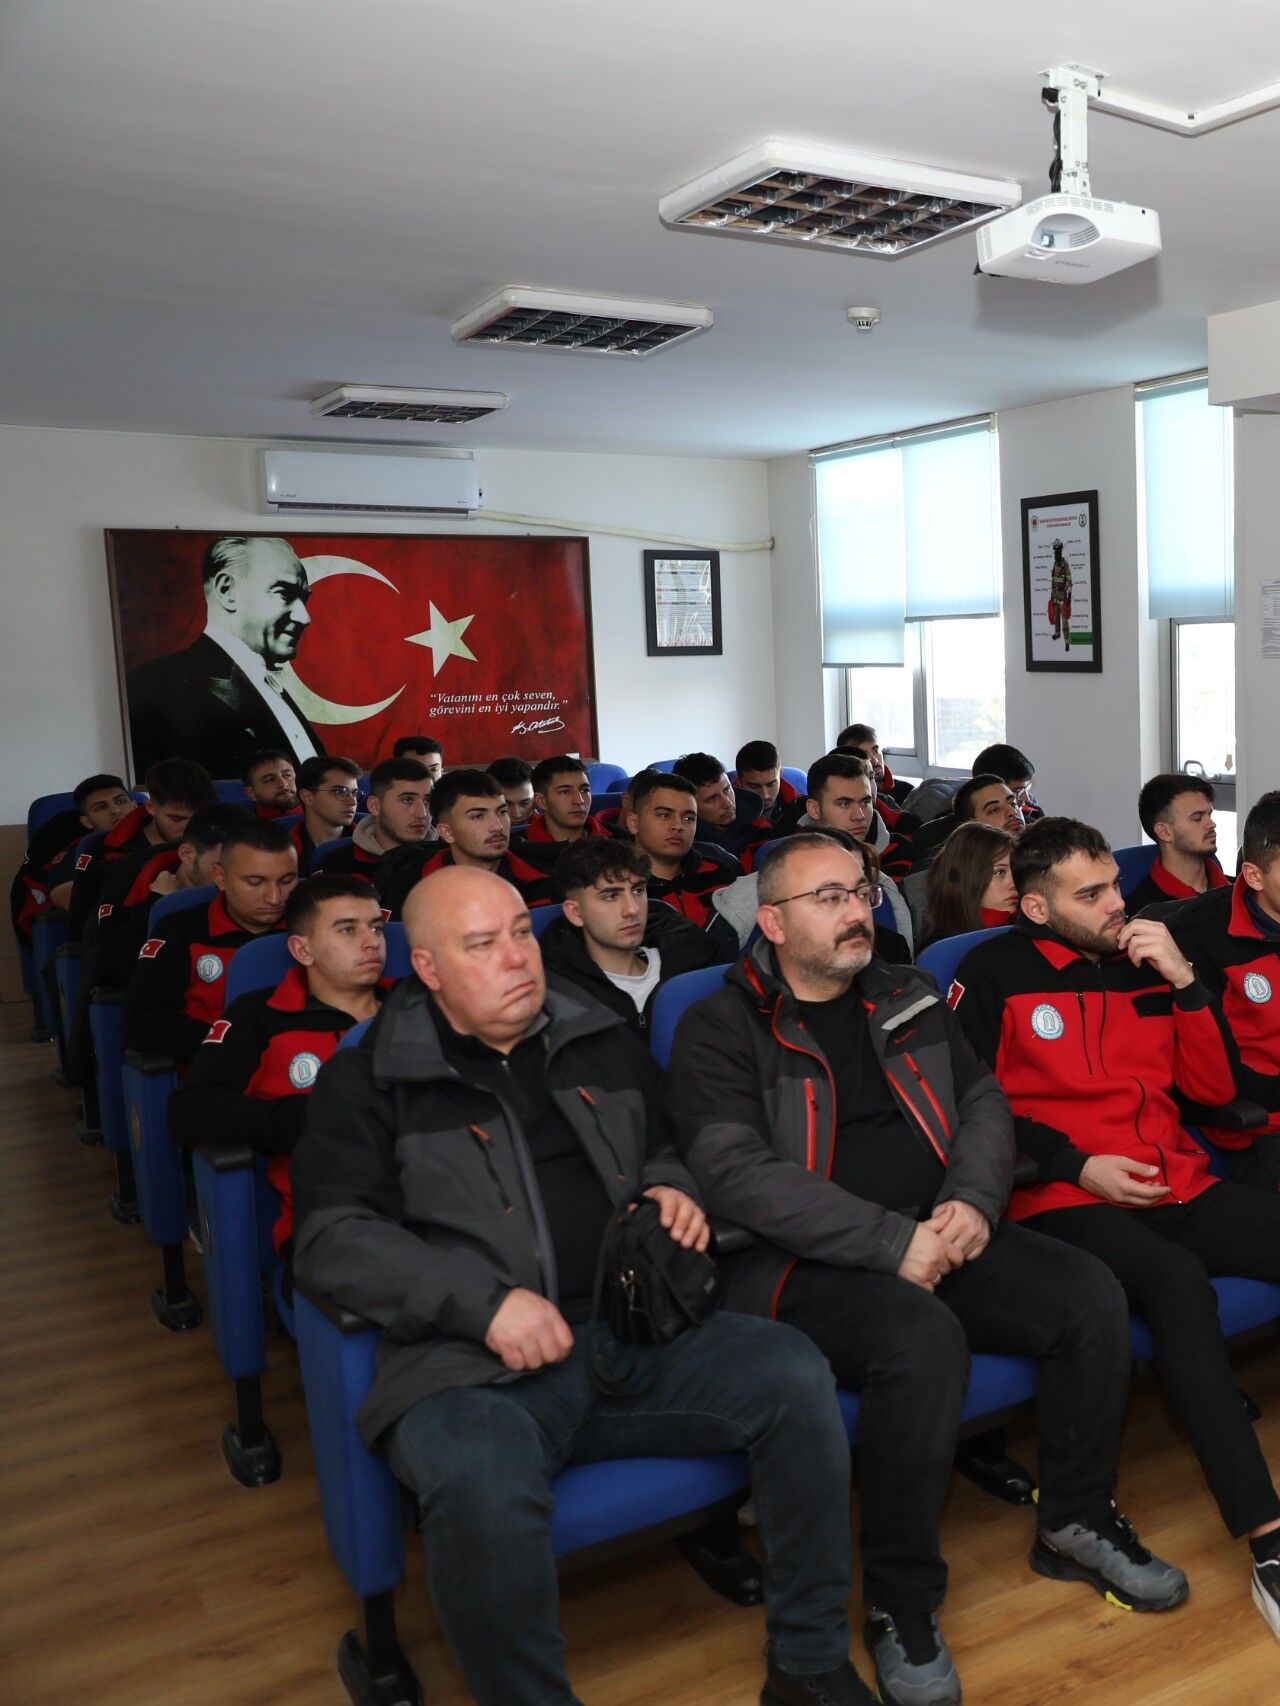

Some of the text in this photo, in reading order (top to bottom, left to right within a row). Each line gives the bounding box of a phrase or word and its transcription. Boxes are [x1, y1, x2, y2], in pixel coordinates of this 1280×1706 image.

[486, 693, 498, 702] en
[502, 691, 521, 703] çok
[523, 691, 556, 701] seven,
[429, 703, 475, 717] görevini
[479, 704, 491, 713] en
[495, 703, 508, 714] iyi
